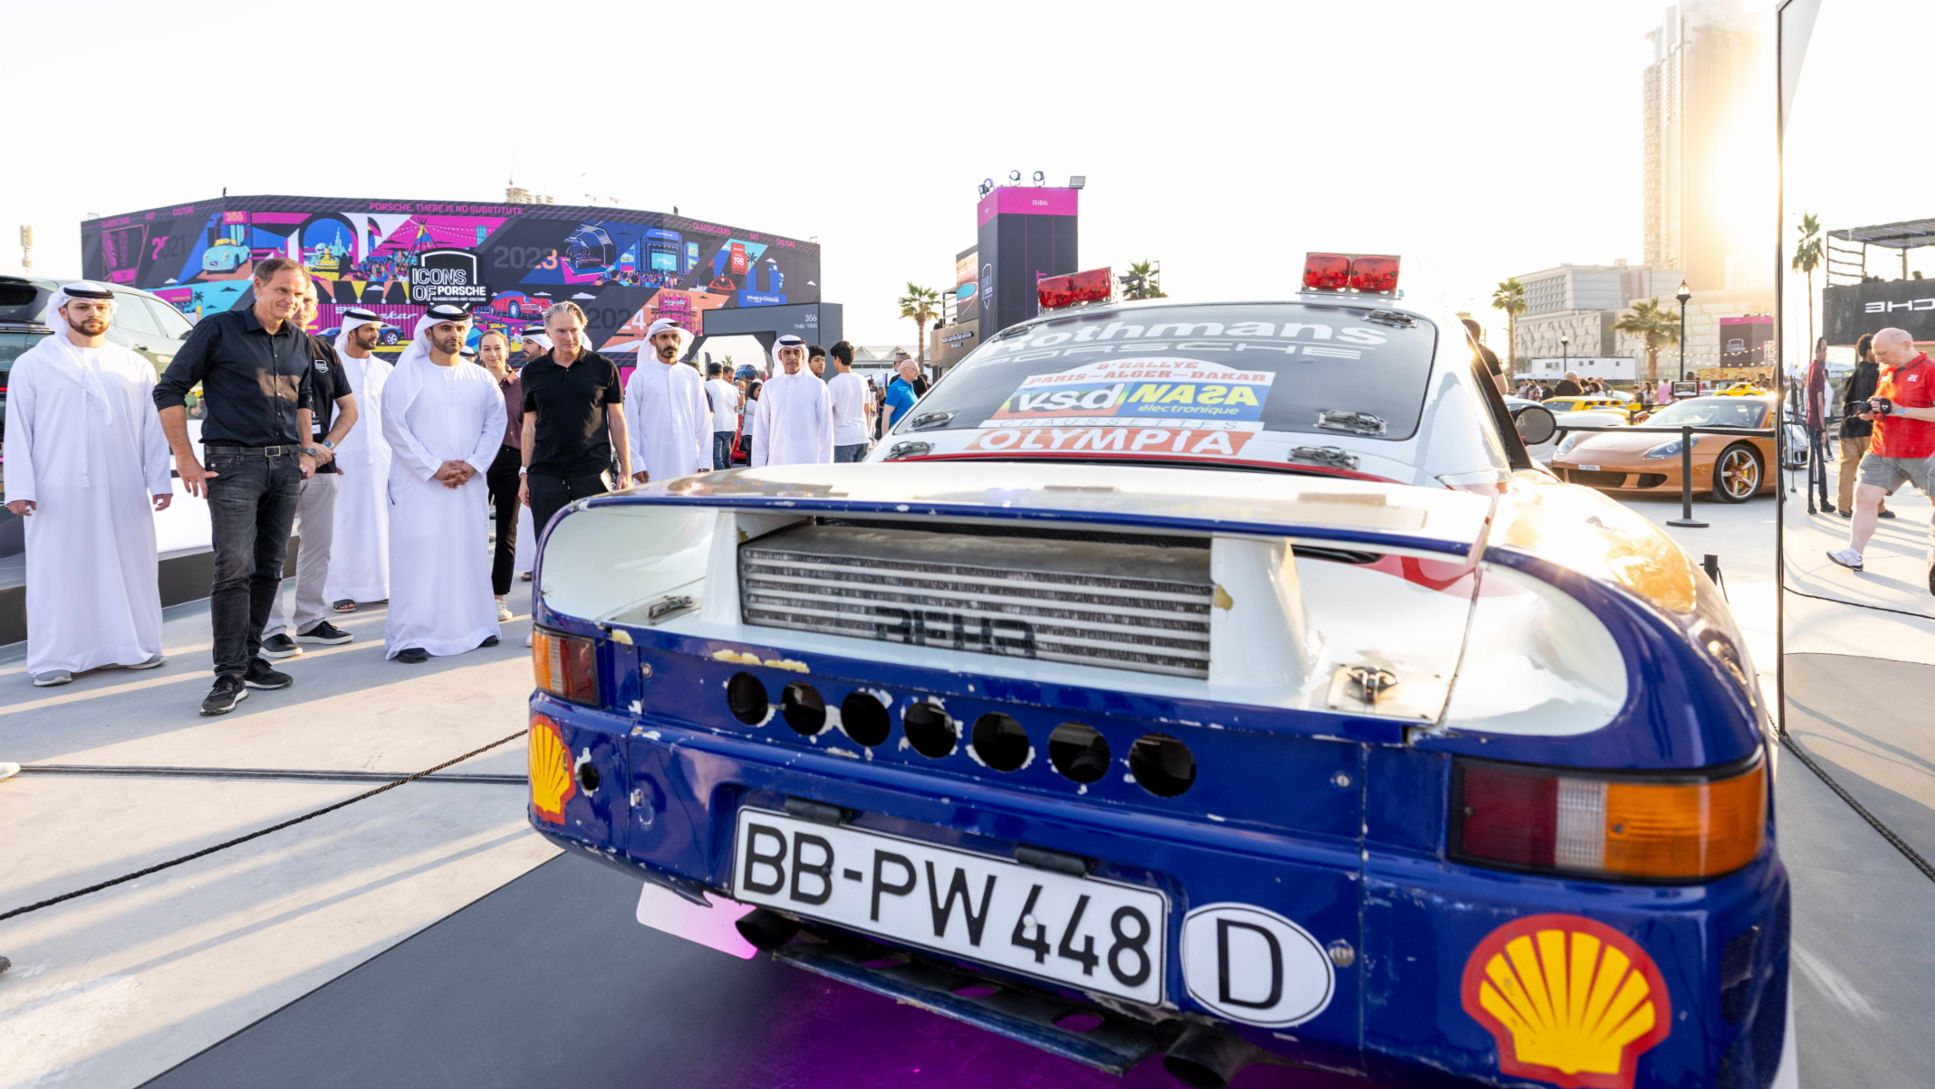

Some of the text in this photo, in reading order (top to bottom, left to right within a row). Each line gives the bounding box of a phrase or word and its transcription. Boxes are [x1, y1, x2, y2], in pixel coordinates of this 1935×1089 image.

[416, 203, 444, 213] THERE
[445, 204, 454, 213] IS
[456, 204, 468, 214] NO
[470, 205, 523, 215] SUBSTITUTE
[493, 246, 558, 270] 2023
[412, 268, 467, 285] ICONS
[413, 285, 486, 301] OF PORSCHE
[587, 308, 646, 331] 2024
[804, 314, 818, 322] 356
[977, 322, 1387, 357] Rothmans
[1119, 361, 1199, 370] RALLYE
[1018, 383, 1126, 411] vsd
[1128, 384, 1259, 407] NASA
[979, 429, 1234, 455] OLYMPIA
[1011, 884, 1151, 987] 448
[1216, 918, 1284, 1010] D
